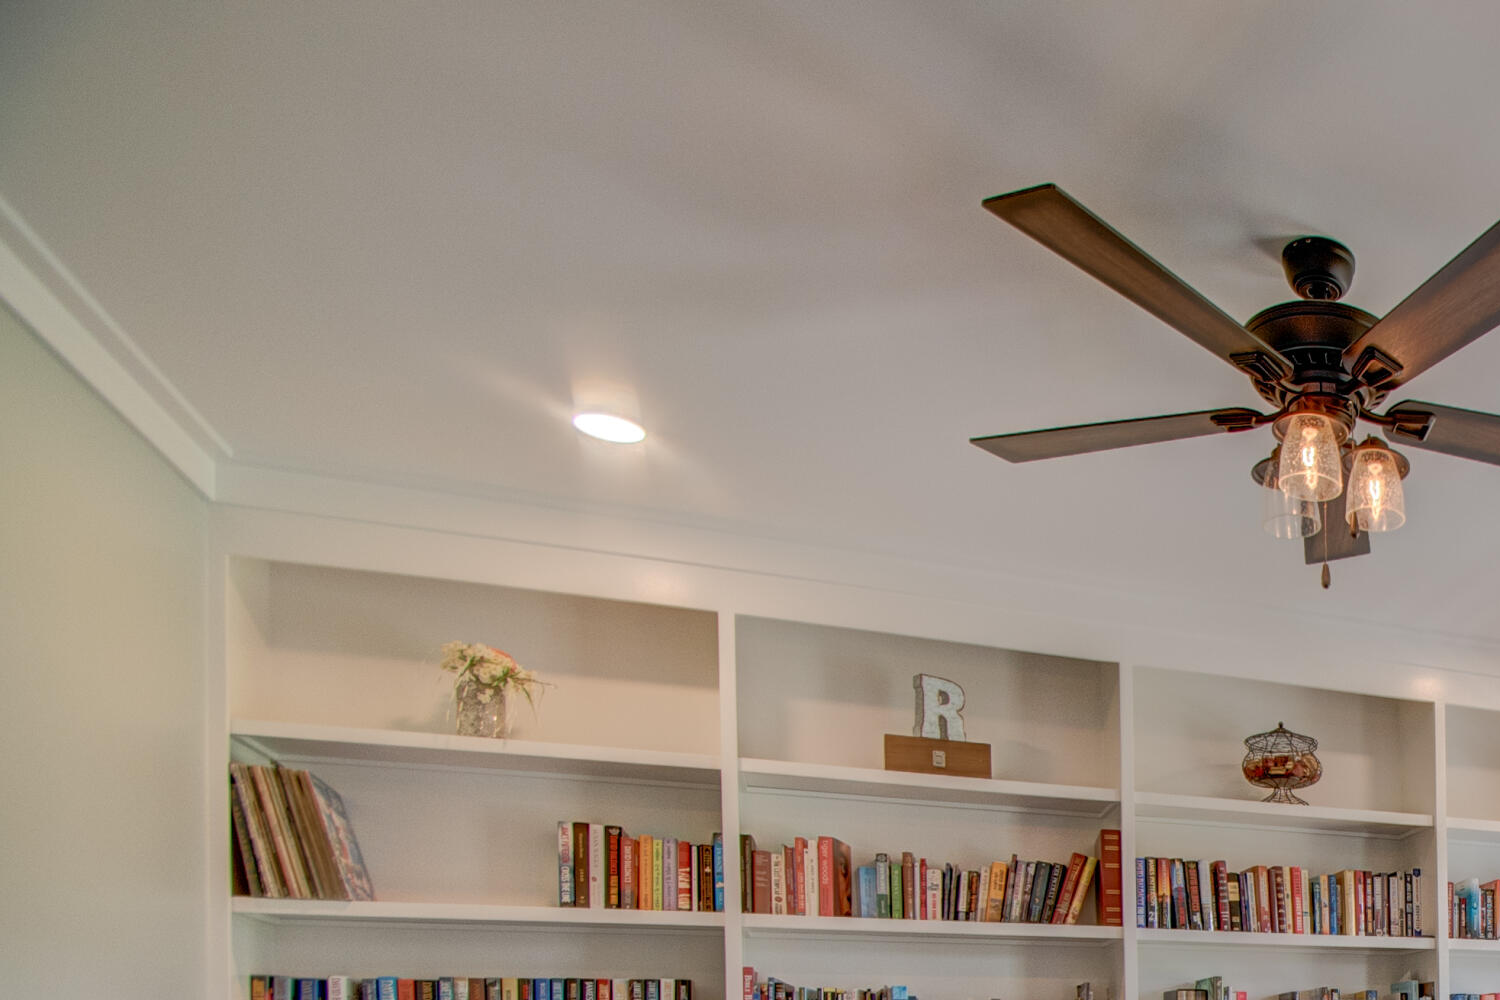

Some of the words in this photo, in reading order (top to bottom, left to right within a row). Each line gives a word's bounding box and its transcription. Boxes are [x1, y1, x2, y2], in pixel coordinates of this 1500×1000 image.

[913, 674, 966, 742] R
[560, 866, 571, 882] CROSS
[821, 860, 829, 885] woods
[561, 890, 571, 903] LINE
[333, 978, 343, 996] DAVID
[422, 982, 434, 1000] DAVID
[585, 982, 594, 1000] JAMES
